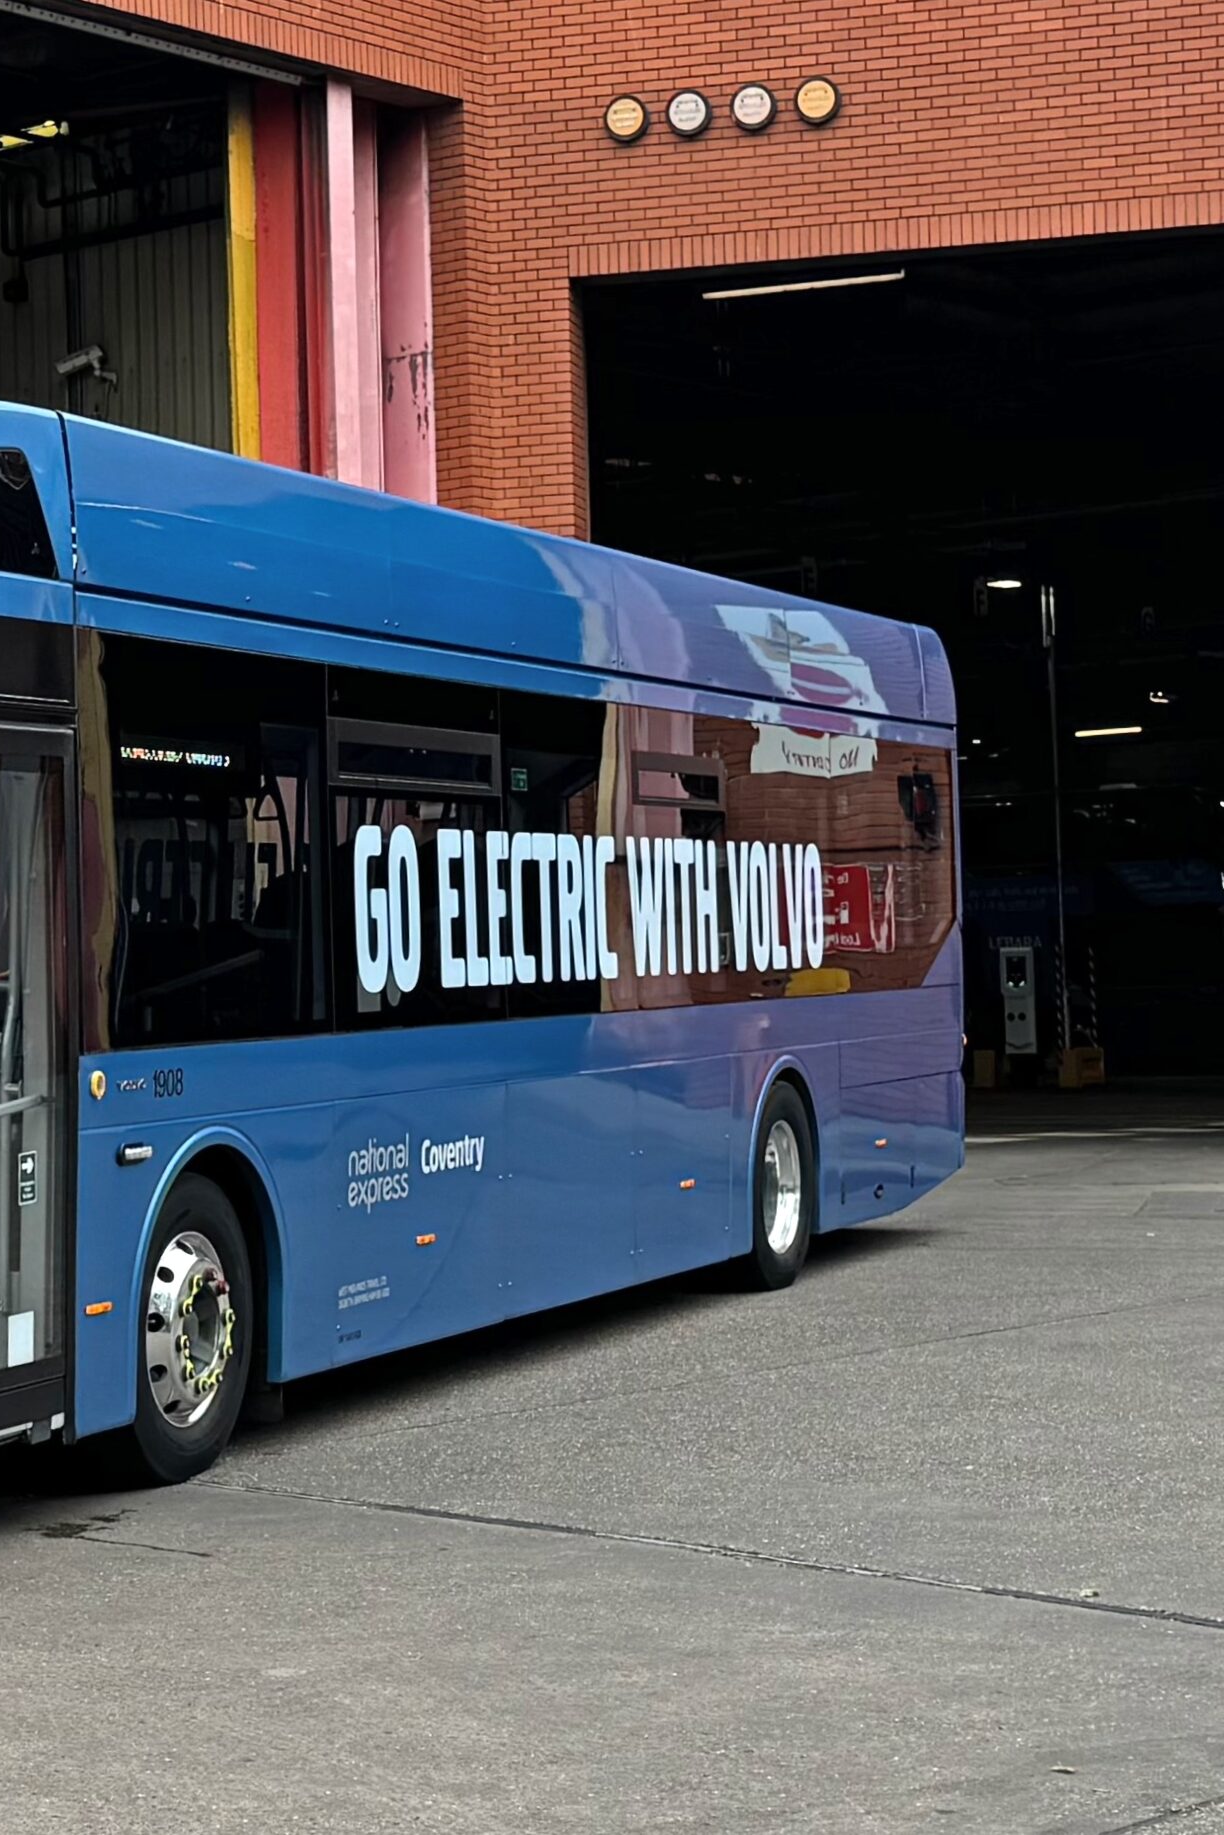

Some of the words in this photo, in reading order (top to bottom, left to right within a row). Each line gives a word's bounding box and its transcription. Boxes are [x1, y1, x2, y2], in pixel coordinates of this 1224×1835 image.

[354, 824, 421, 993] GO
[436, 828, 618, 988] ELECTRIC
[626, 836, 719, 977] WITH
[727, 840, 824, 972] VOLVO
[153, 1068, 183, 1098] 1908
[348, 1132, 409, 1177] national
[420, 1134, 485, 1174] Coventry
[347, 1172, 409, 1214] express
